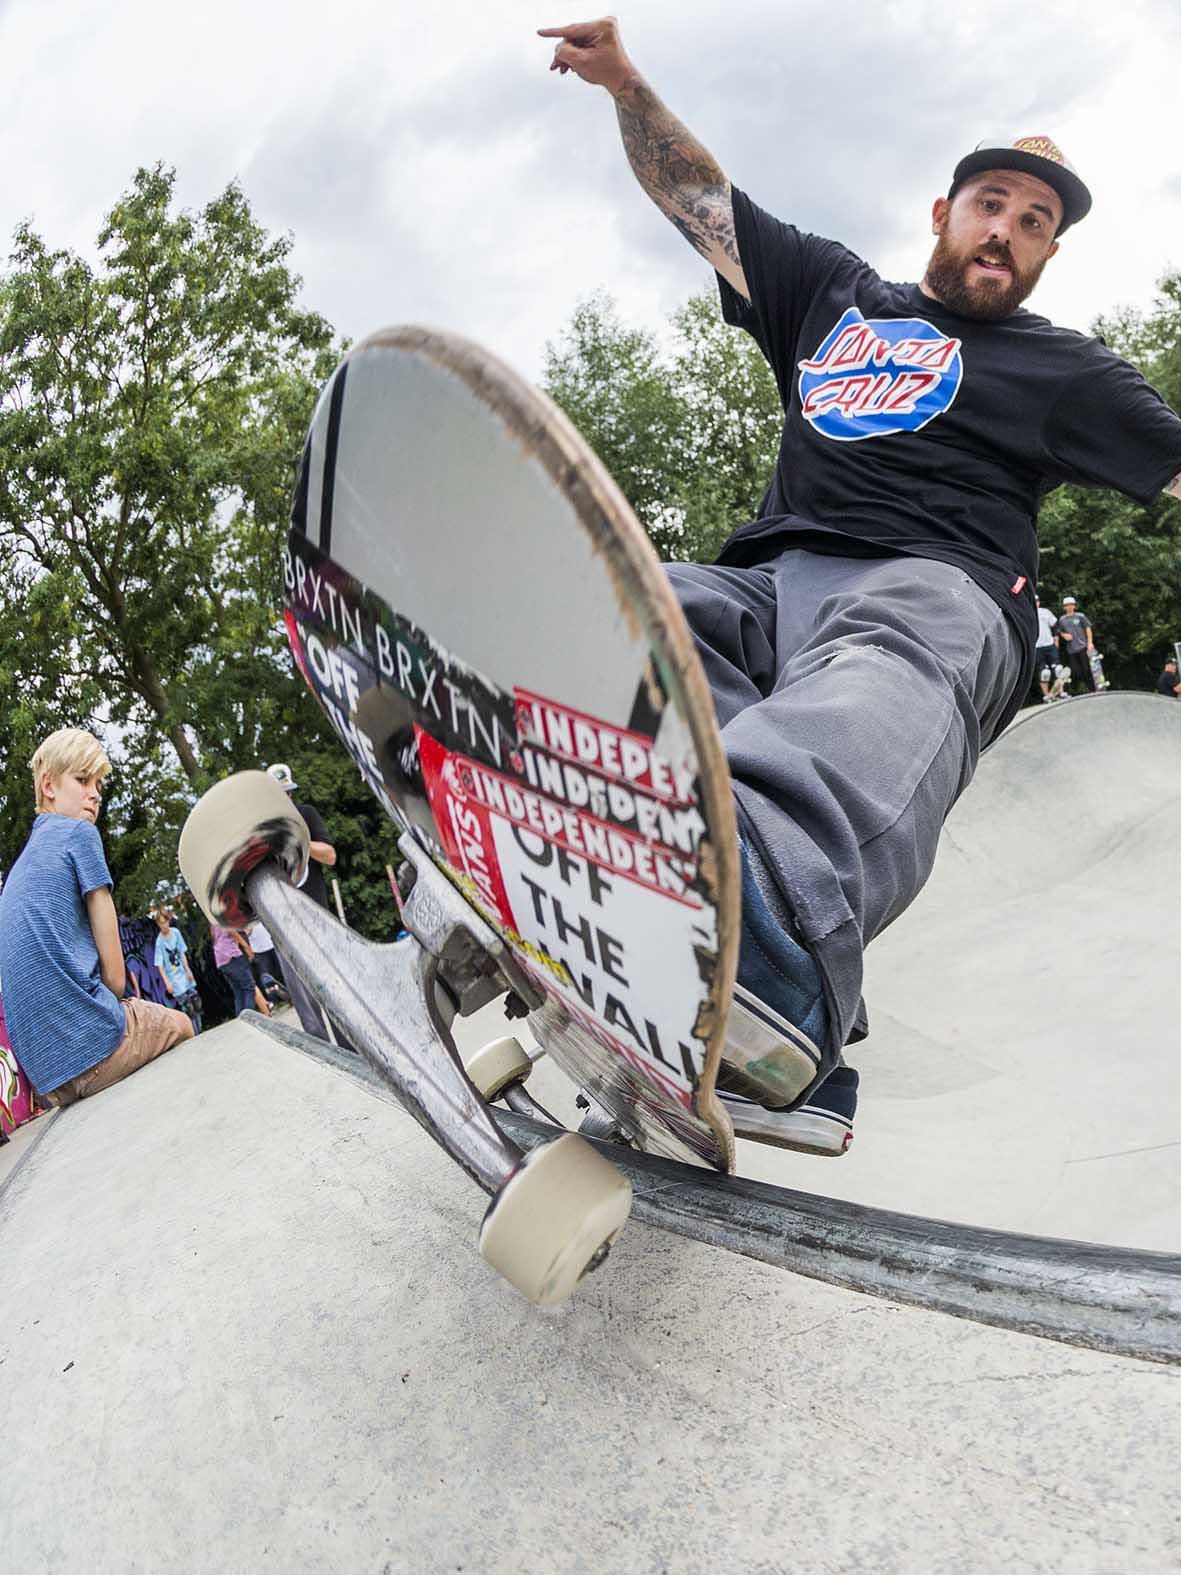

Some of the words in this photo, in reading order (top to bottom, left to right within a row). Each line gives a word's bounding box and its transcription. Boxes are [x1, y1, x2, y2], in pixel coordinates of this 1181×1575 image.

[798, 322, 962, 375] SANTA
[802, 371, 942, 419] CRUZ
[283, 549, 365, 657] BRXTN
[376, 623, 502, 768] BRXTN
[520, 872, 630, 989] THE
